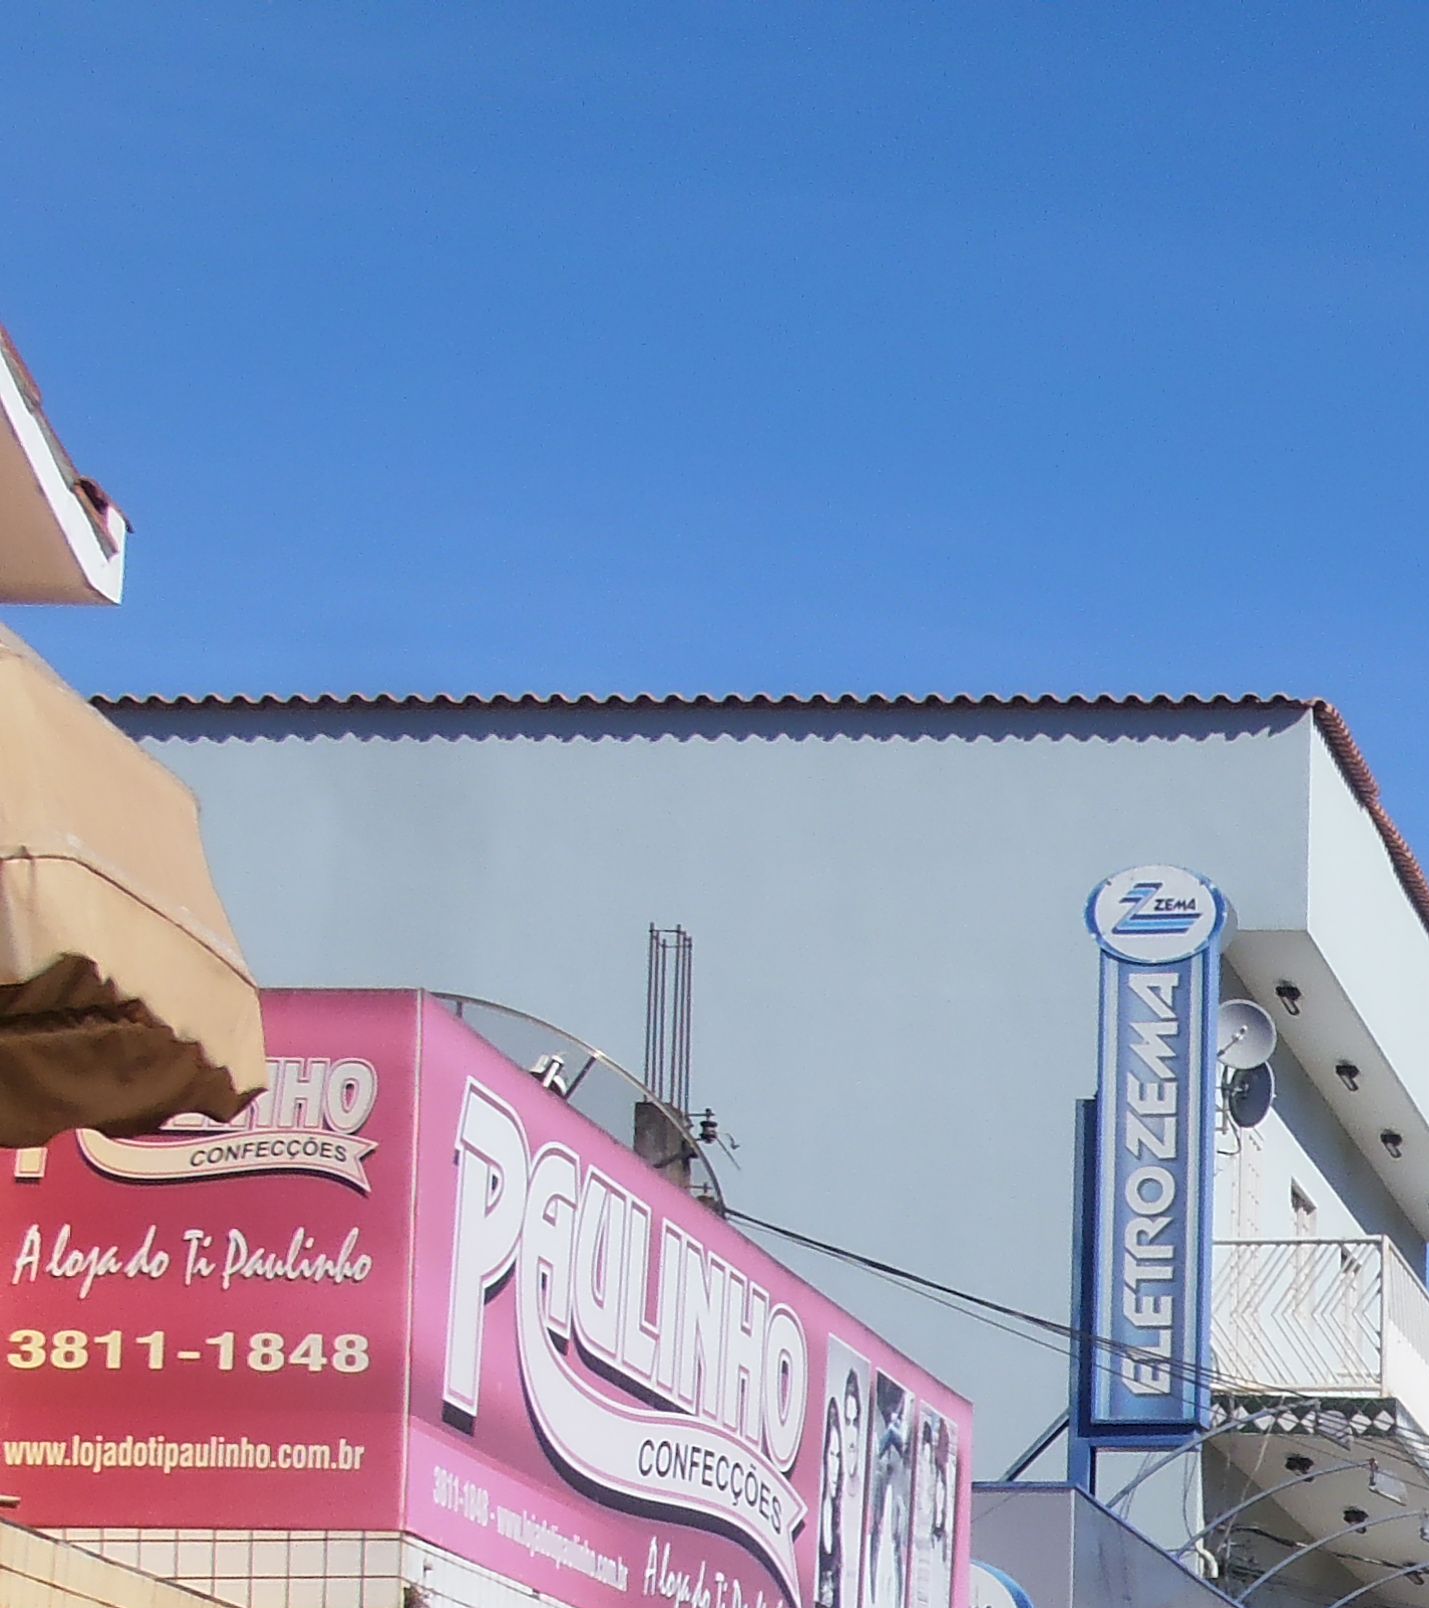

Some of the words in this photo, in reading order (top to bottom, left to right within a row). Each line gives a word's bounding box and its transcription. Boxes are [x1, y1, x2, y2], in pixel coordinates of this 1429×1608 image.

[1153, 898, 1197, 912] ZEMA
[189, 1136, 348, 1167] CONFECÇÕES
[1121, 972, 1180, 1399] ELETROZEMA
[12, 1223, 41, 1285] A
[182, 1228, 216, 1287] Ti
[222, 1226, 373, 1291] Paulinho
[443, 1075, 809, 1472] PAULINHO
[7, 1328, 371, 1374] 3811-1848
[3, 1435, 366, 1474] www.lojadotipaulinho.com.br
[639, 1437, 784, 1536] CONFECÇÕES
